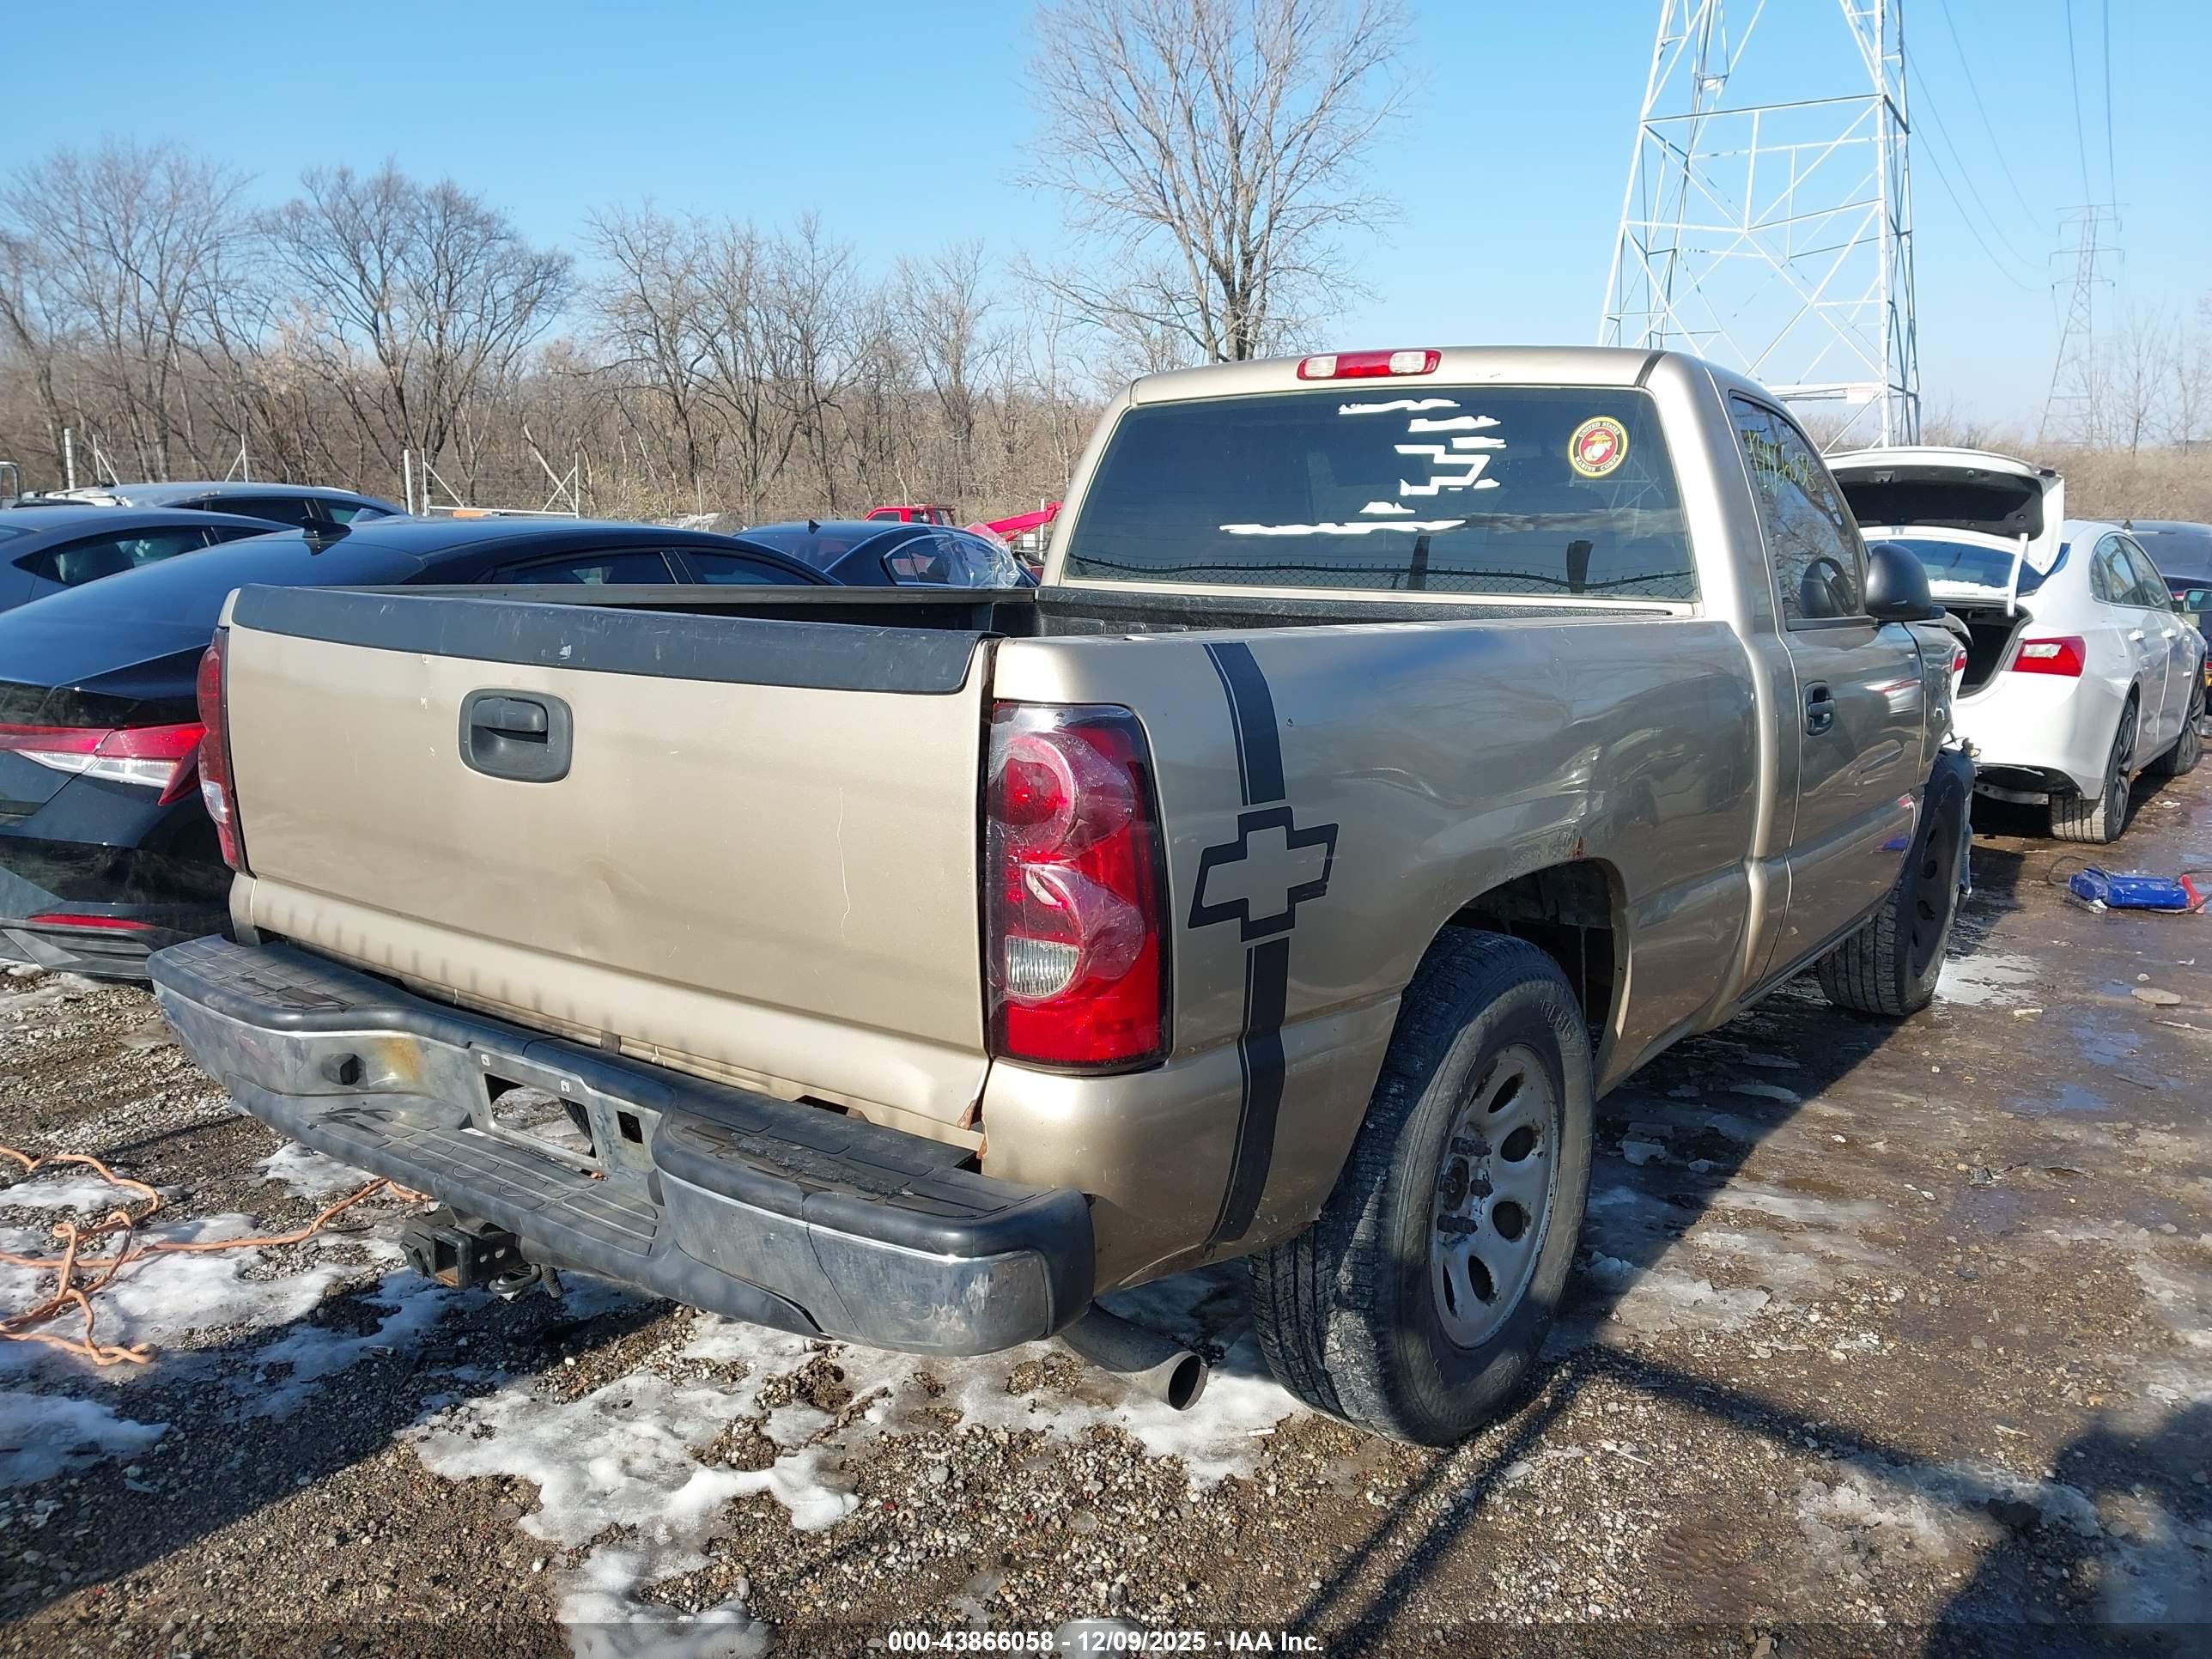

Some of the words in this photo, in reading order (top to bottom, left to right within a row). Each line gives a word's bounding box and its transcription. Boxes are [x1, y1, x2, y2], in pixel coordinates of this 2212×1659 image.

[1578, 422, 1601, 438] UNITED
[1601, 421, 1621, 435] STATES
[1575, 455, 1597, 472] MARINE
[1600, 454, 1620, 471] CORPS
